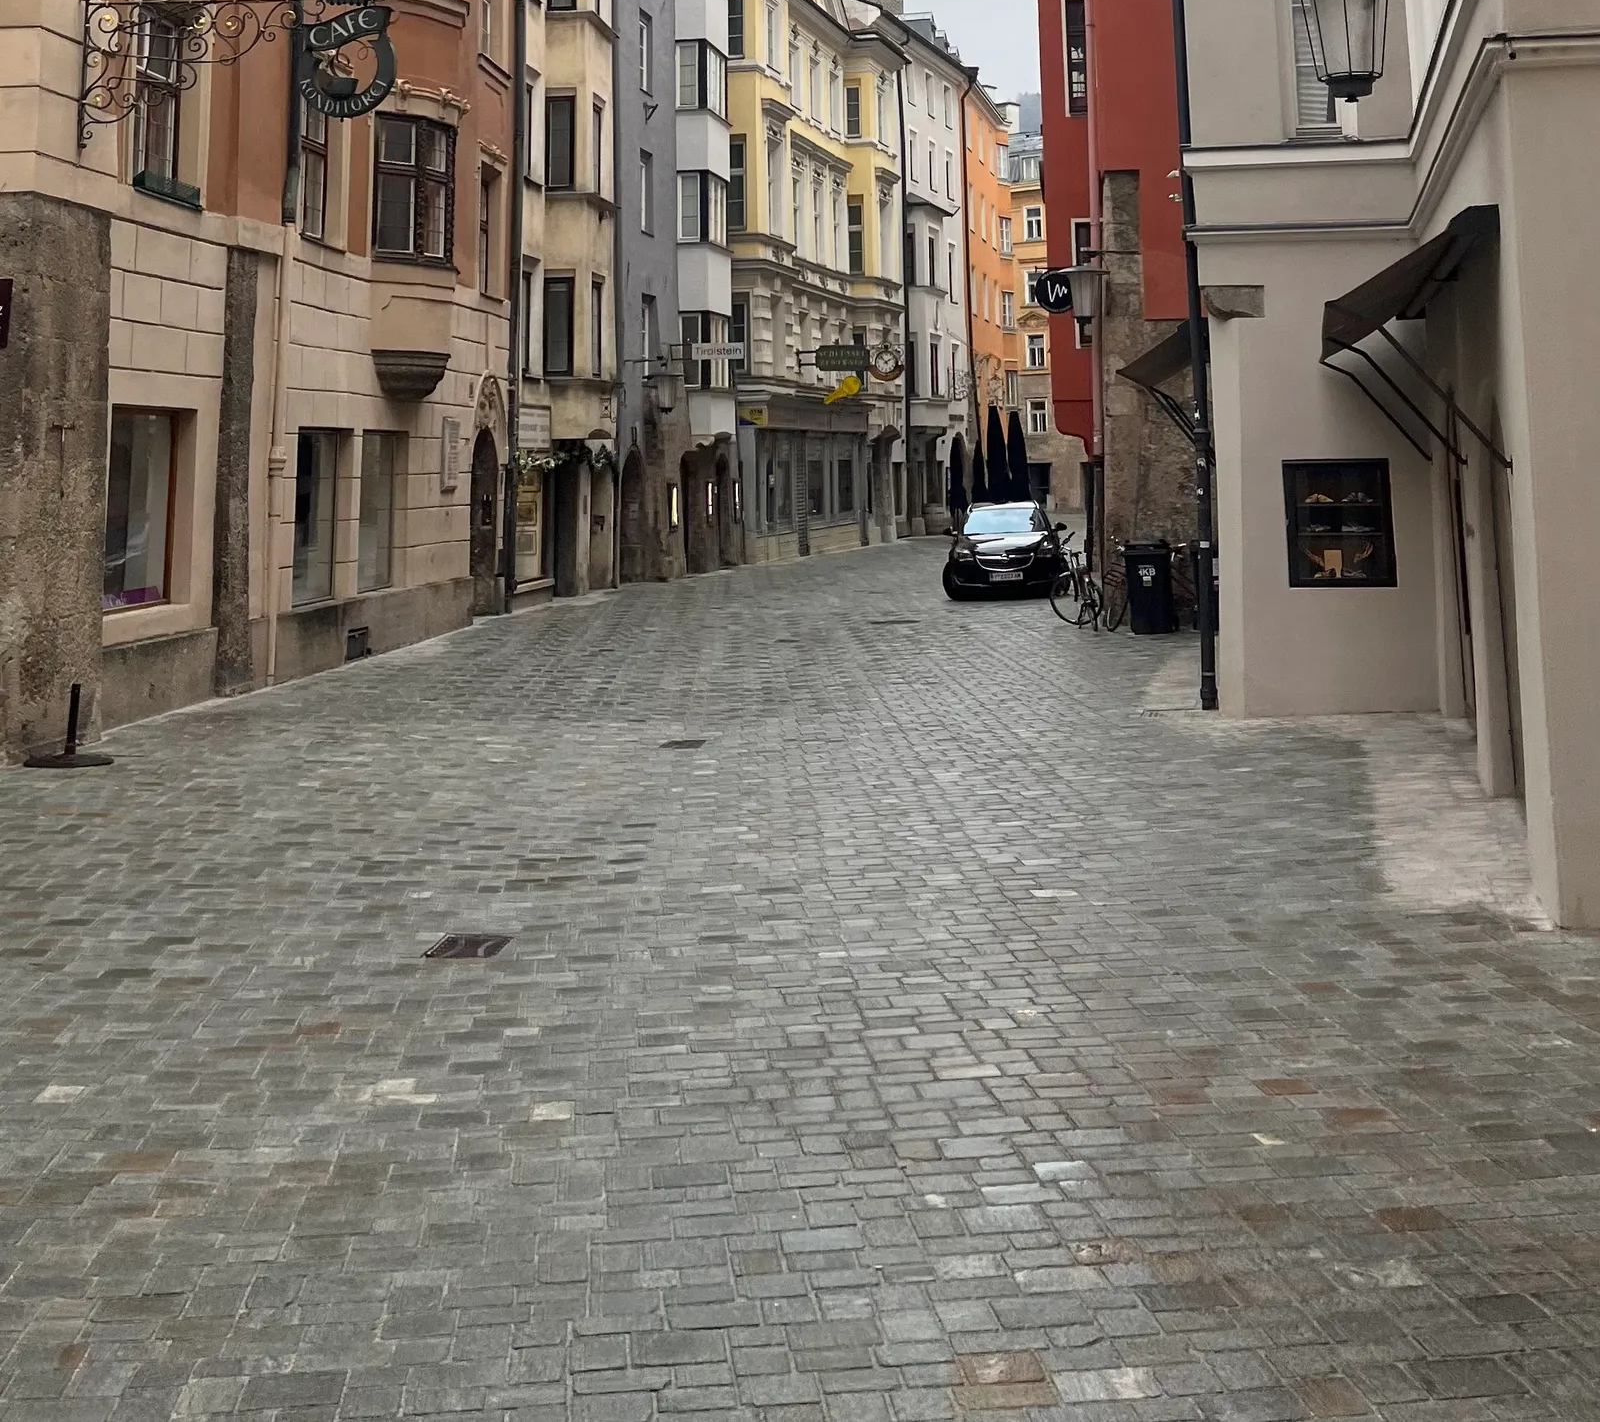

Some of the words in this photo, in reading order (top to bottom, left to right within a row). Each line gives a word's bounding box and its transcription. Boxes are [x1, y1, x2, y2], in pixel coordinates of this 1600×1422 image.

[309, 8, 378, 46] CAFE
[299, 78, 388, 114] KONDITOREI
[695, 346, 742, 356] Tirolstein
